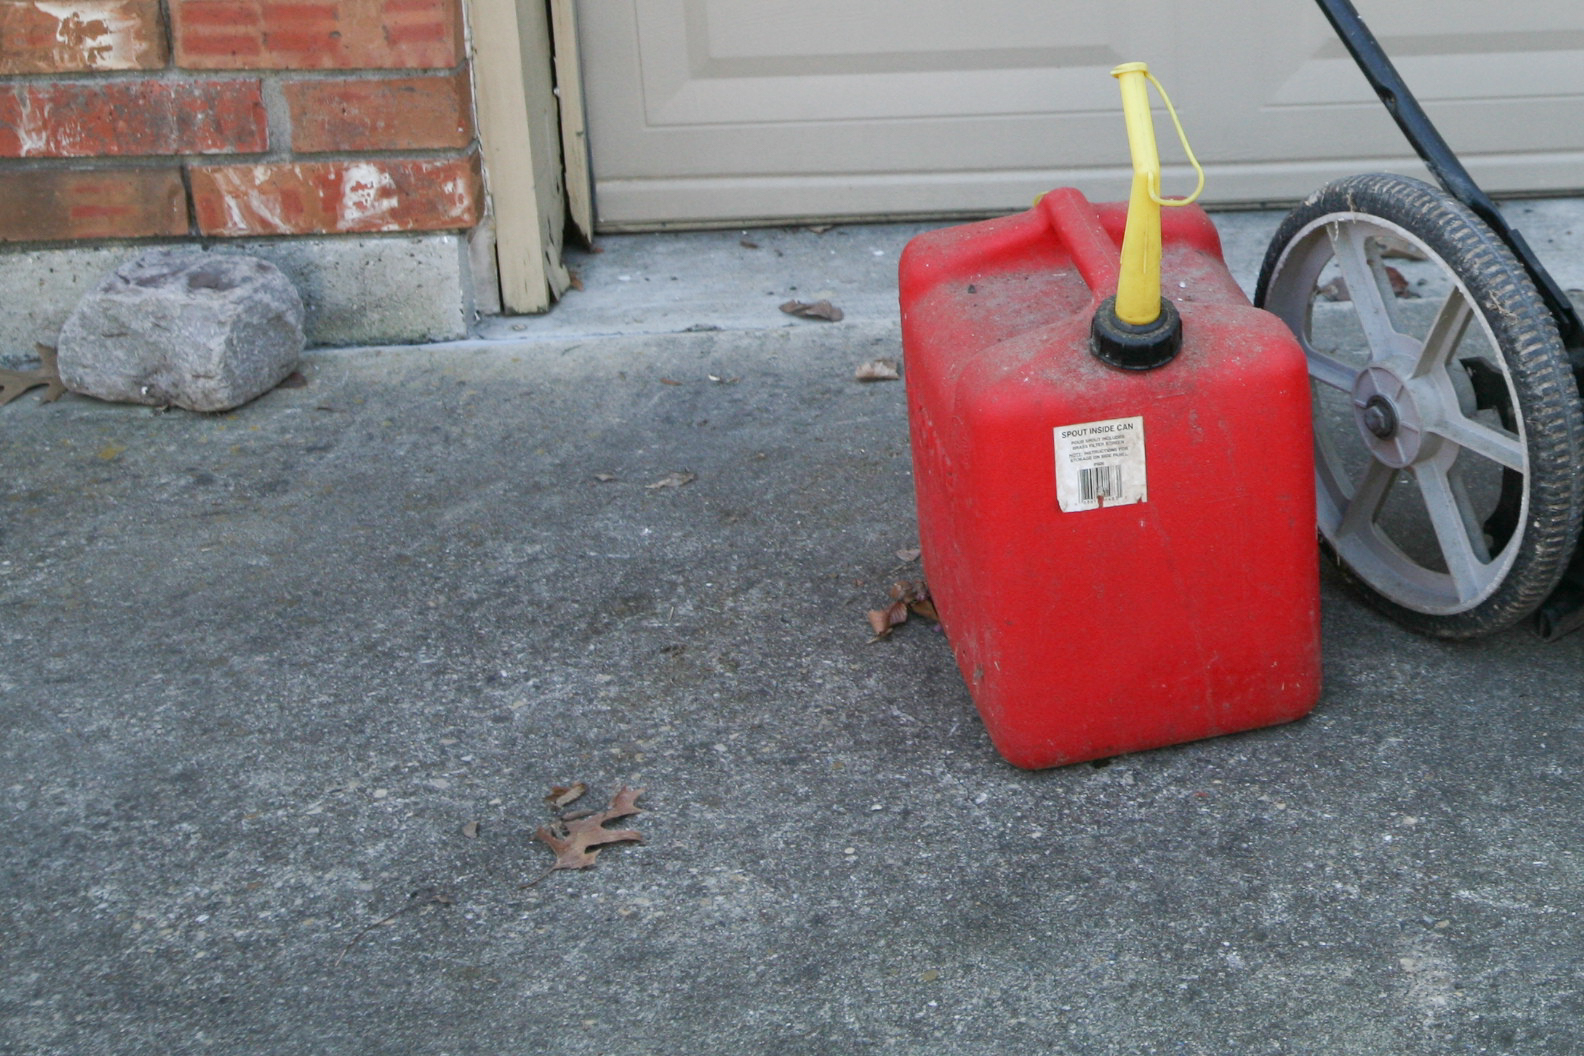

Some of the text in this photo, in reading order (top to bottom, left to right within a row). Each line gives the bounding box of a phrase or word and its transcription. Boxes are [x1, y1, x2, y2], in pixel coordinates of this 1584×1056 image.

[1062, 423, 1134, 438] SPOUT INSIDE CAN
